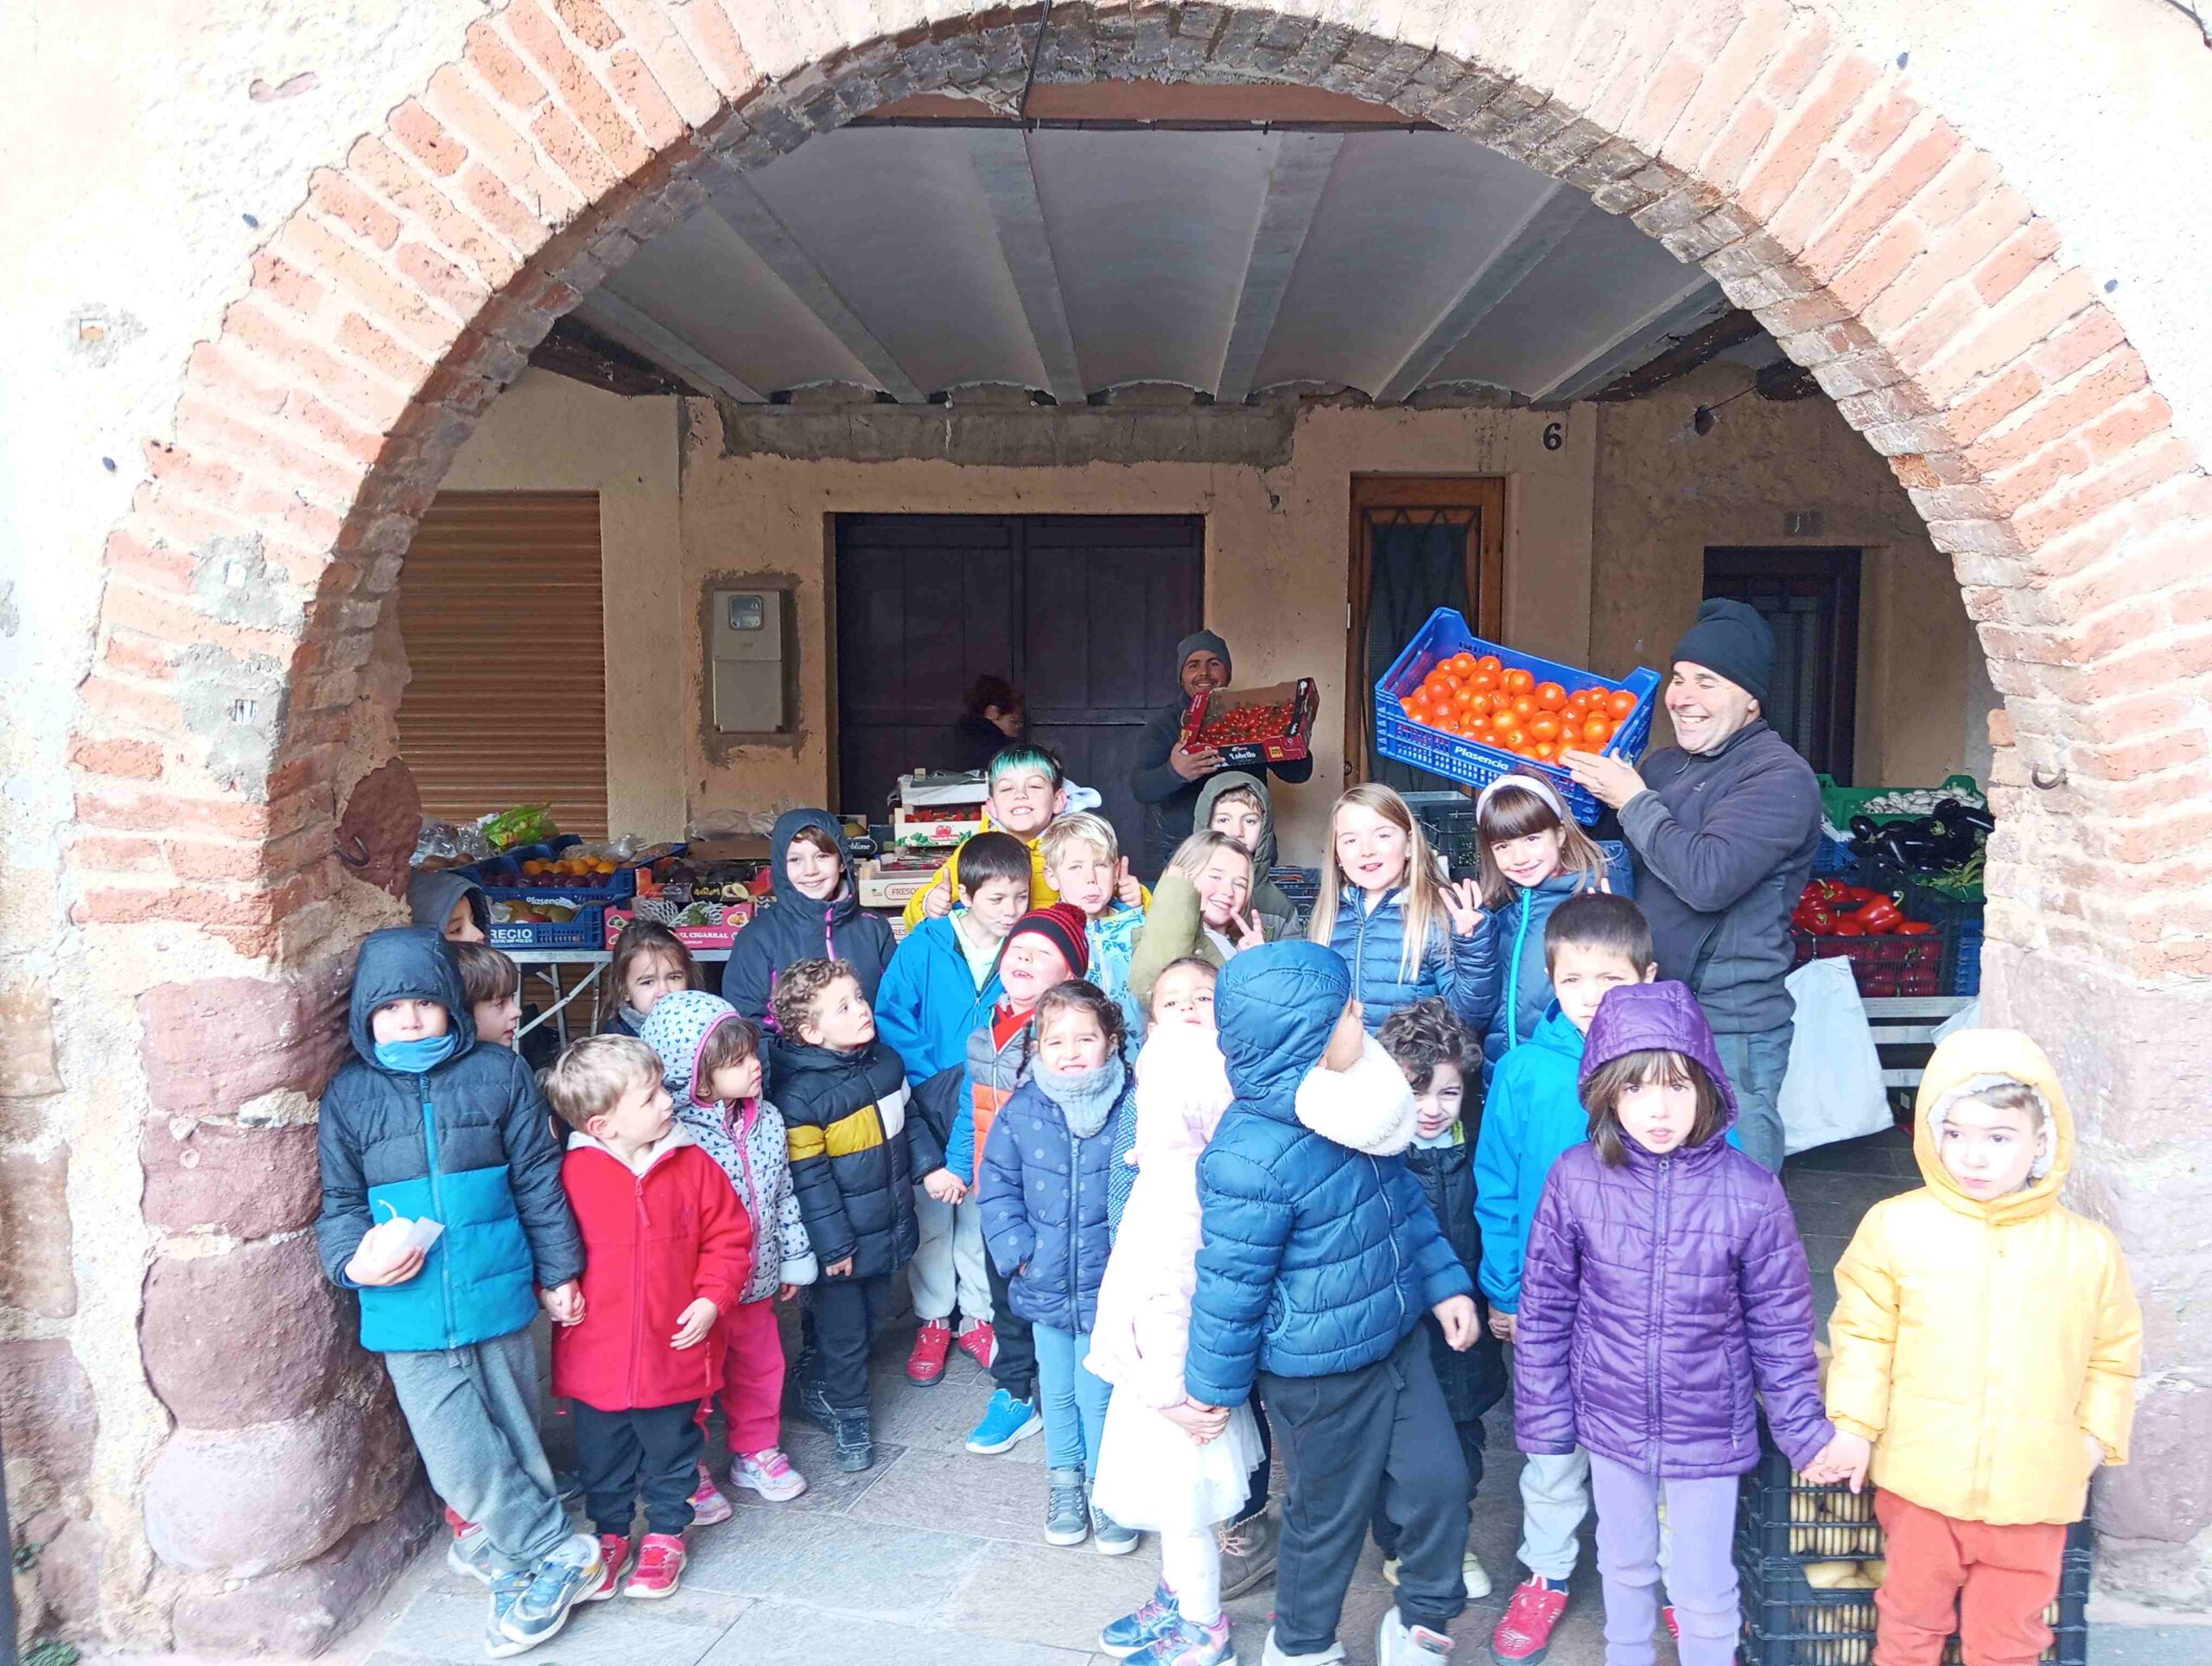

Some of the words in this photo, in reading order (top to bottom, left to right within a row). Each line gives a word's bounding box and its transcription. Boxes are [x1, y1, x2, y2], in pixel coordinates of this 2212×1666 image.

[1543, 423, 1562, 450] 6
[1454, 746, 1510, 771] Plasencia
[849, 842, 871, 850] blime
[892, 887, 918, 896] FRESO
